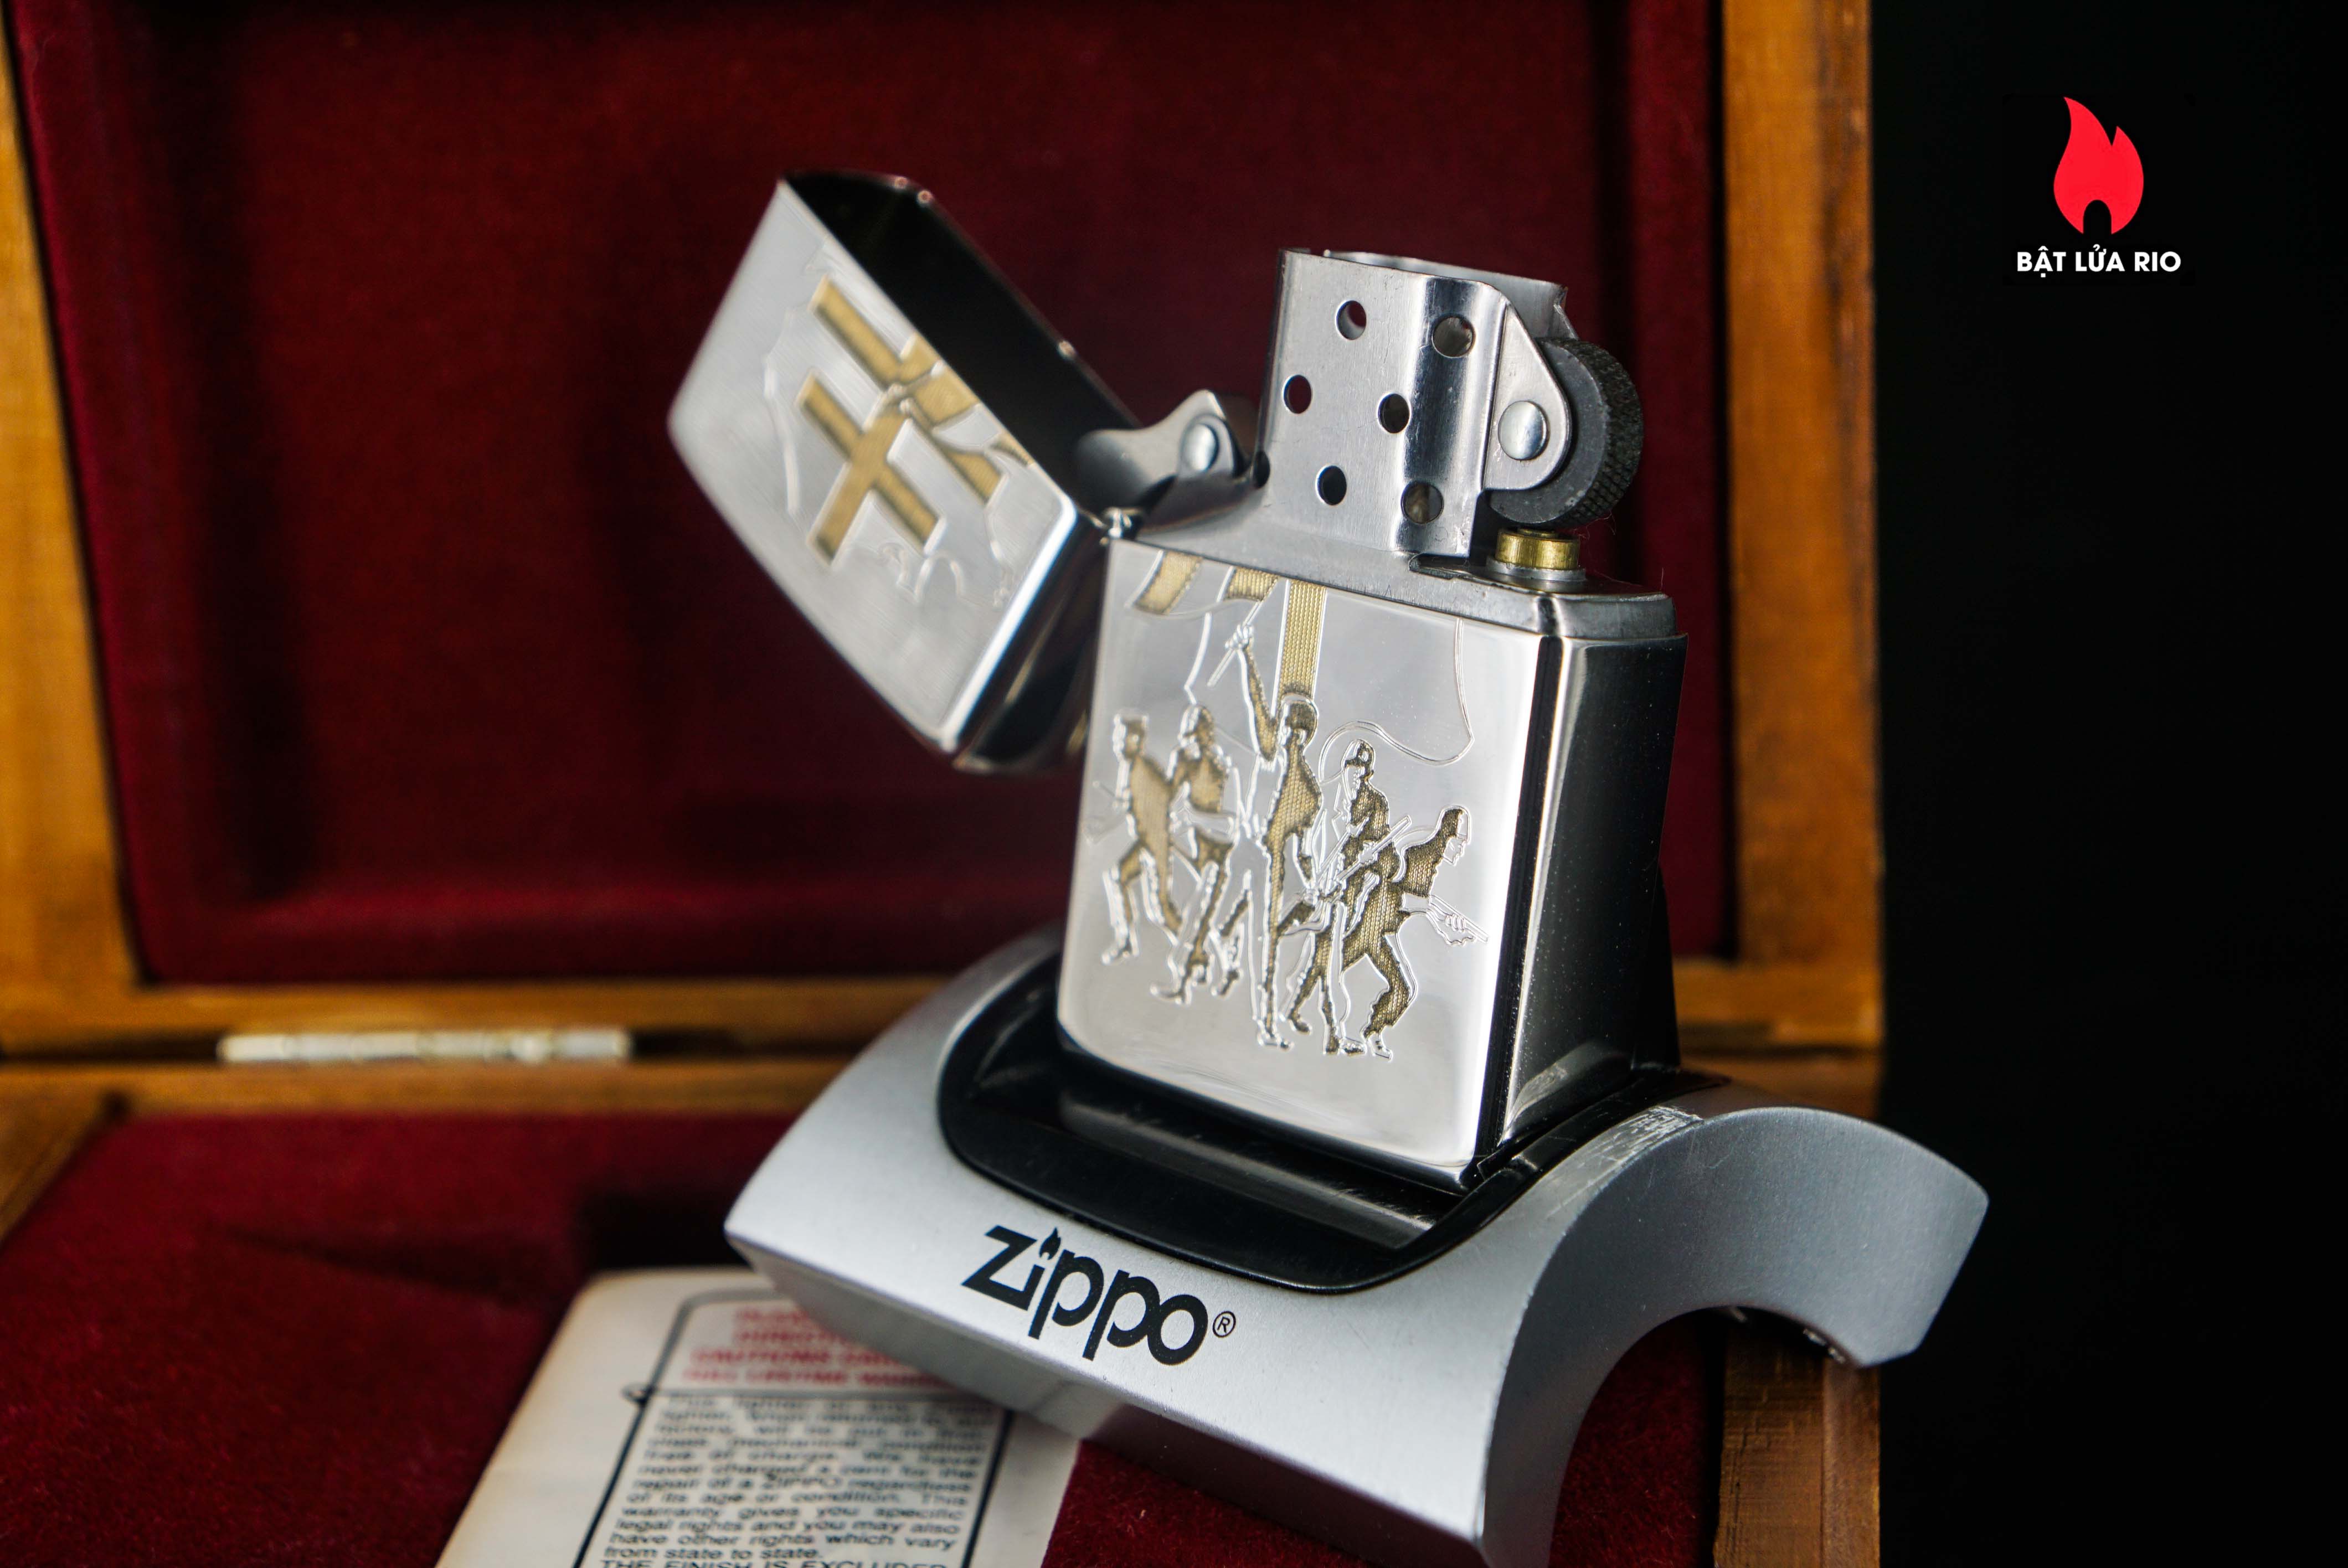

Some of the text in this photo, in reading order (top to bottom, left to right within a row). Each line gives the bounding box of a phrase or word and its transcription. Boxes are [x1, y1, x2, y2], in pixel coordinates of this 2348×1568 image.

[602, 1545, 658, 1557] from
[664, 1548, 724, 1559] state
[730, 1549, 753, 1560] to
